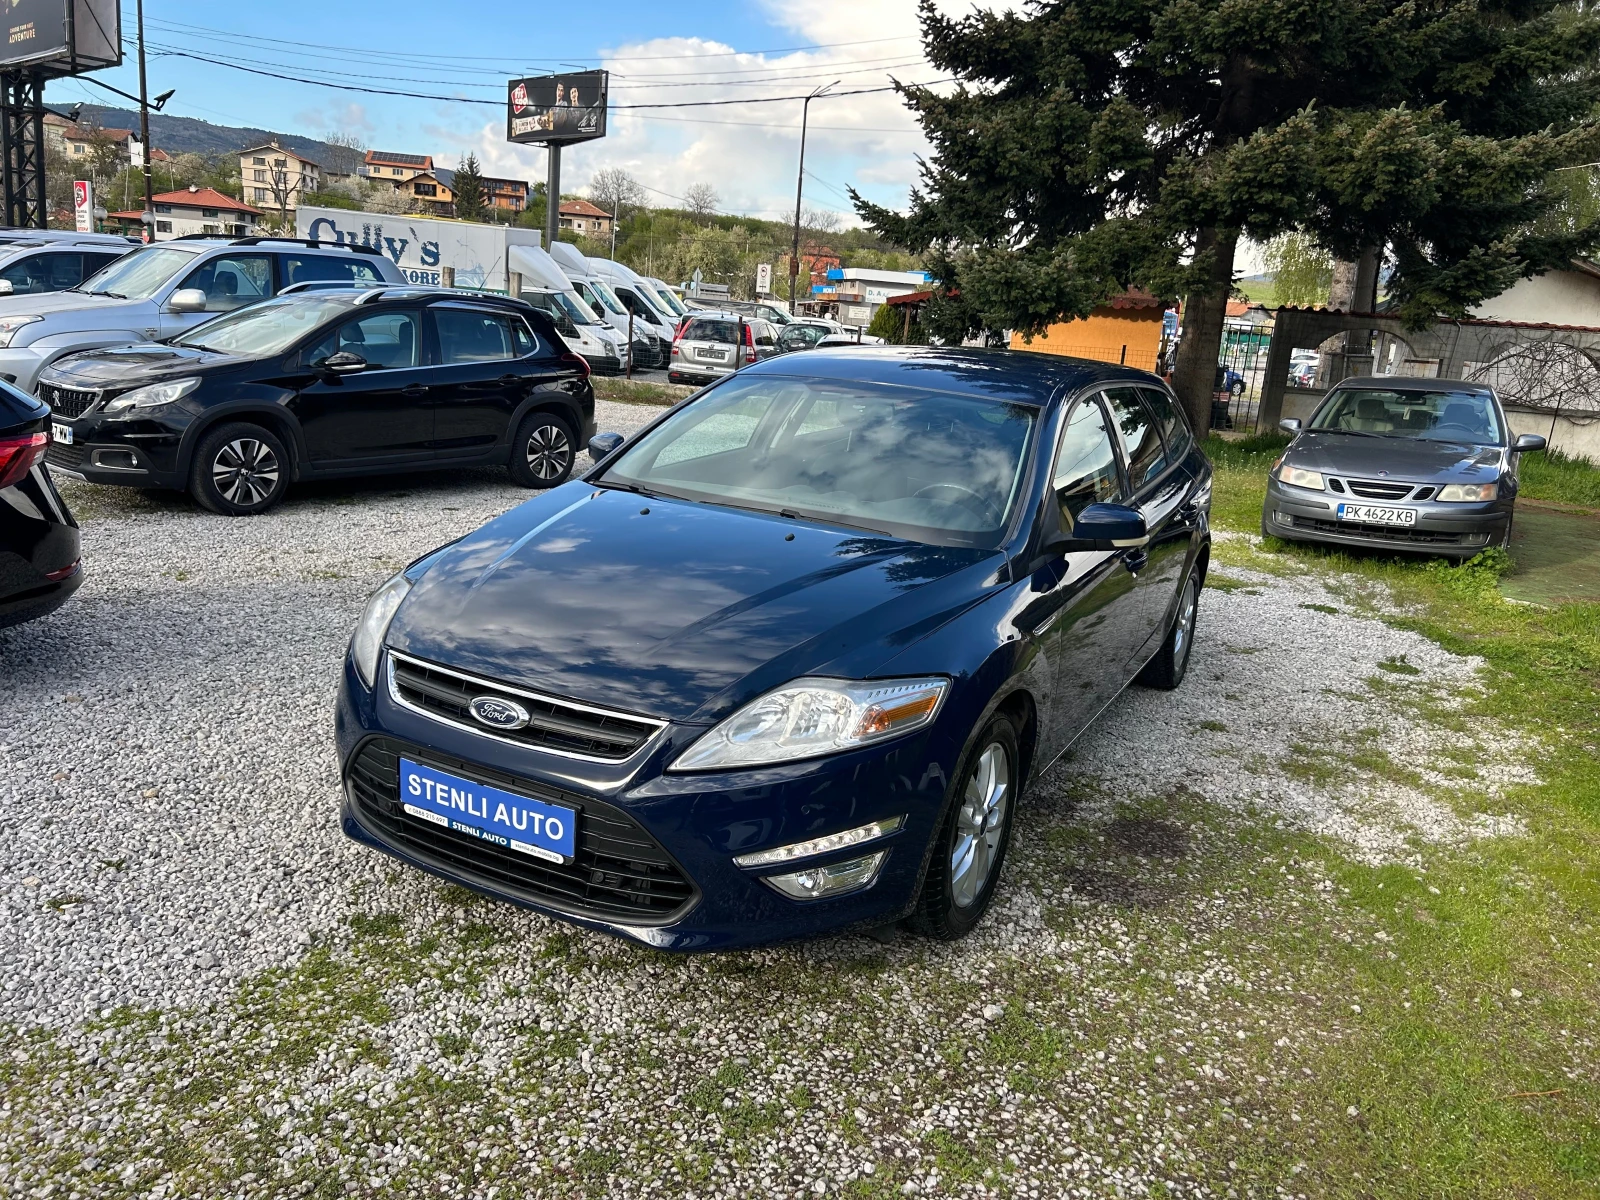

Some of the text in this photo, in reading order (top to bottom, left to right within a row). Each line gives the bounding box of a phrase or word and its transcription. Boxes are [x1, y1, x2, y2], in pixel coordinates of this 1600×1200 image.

[9, 29, 36, 43] ADVENTURE
[53, 425, 68, 441] 7-MW
[1345, 506, 1362, 518] PK
[1364, 508, 1395, 521] 4622
[1396, 510, 1413, 523] KB
[480, 703, 507, 722] Ford
[407, 773, 564, 841] STENLI AUTO
[425, 812, 436, 821] 215
[452, 821, 480, 837] STENLI
[482, 830, 508, 846] AUTO
